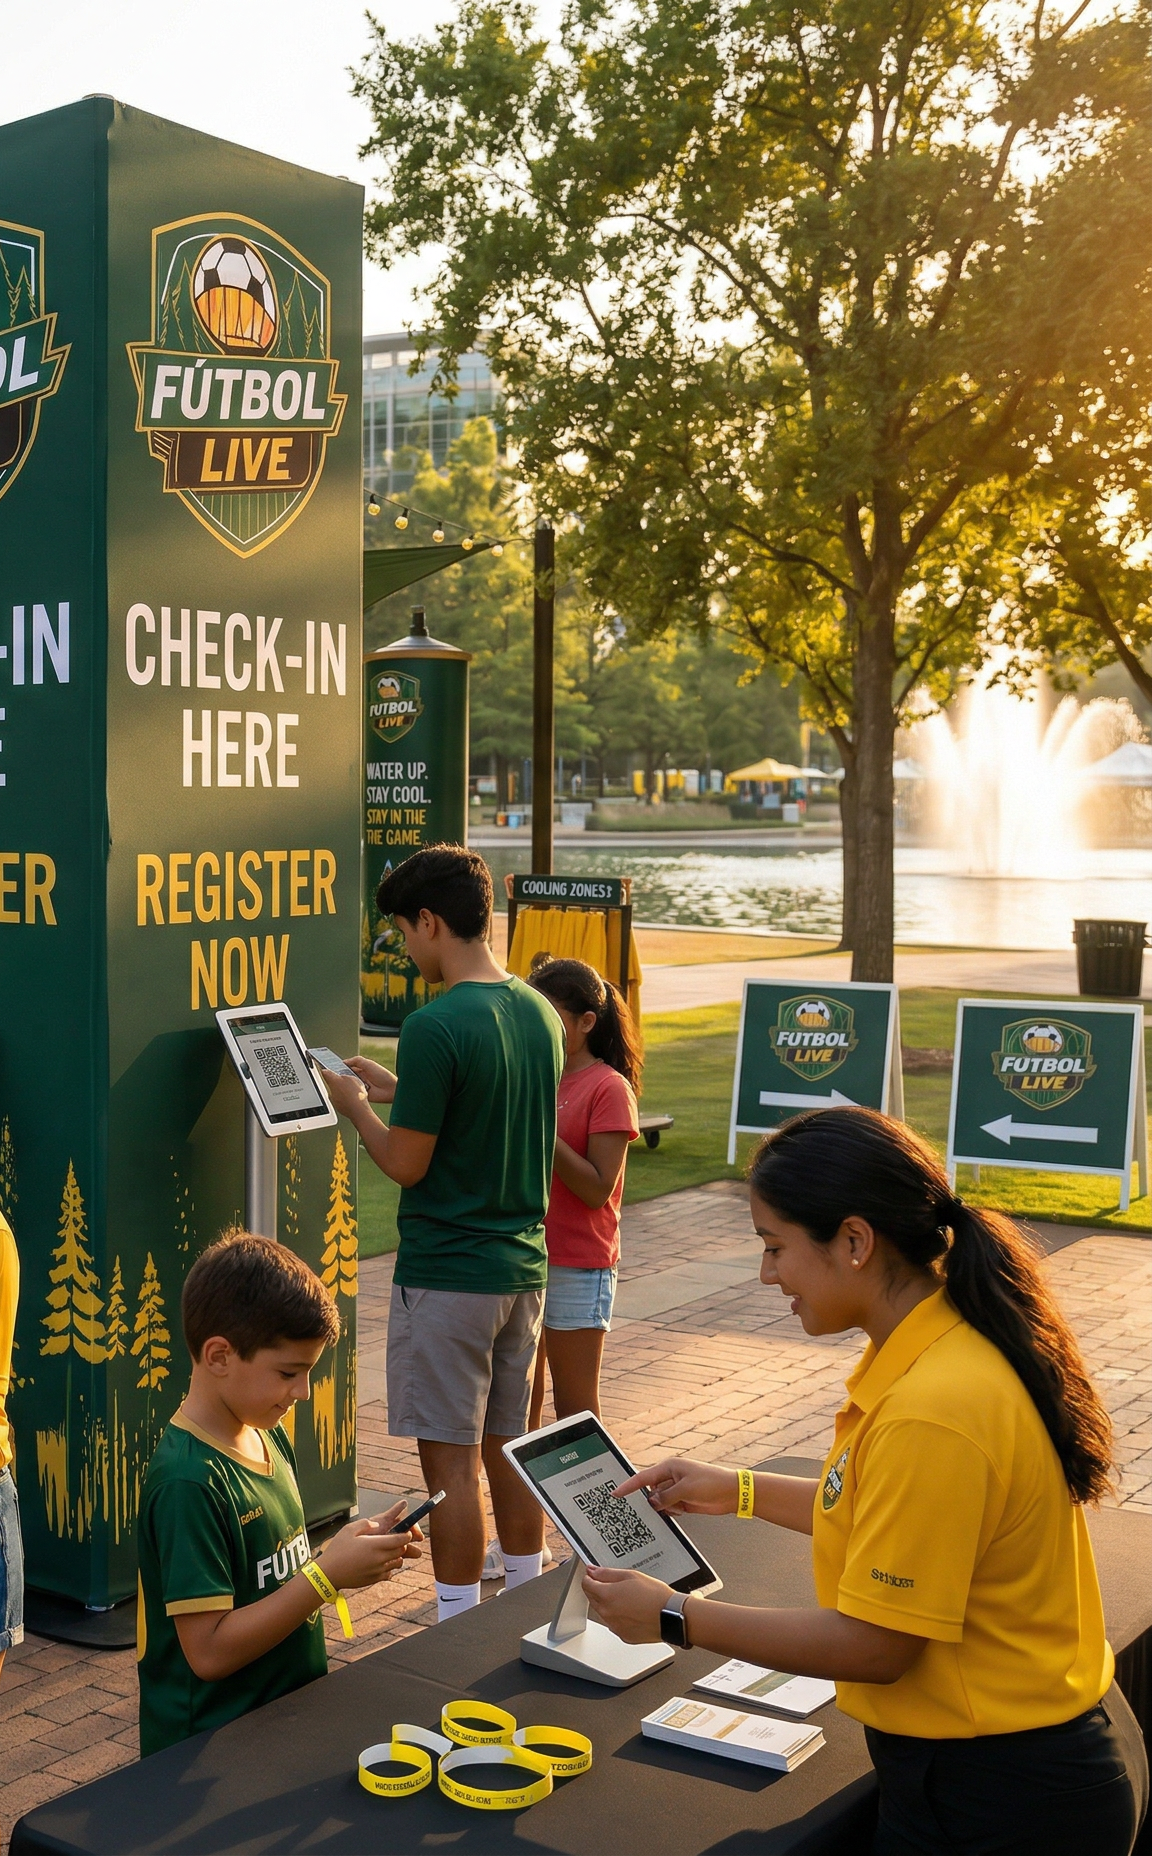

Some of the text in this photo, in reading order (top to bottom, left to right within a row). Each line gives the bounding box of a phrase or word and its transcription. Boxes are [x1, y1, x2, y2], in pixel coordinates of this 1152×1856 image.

[150, 357, 327, 421] FÚTBOL
[199, 437, 294, 482] LIVE
[125, 602, 348, 696] CHECK-IN
[378, 715, 404, 729] LIVE
[182, 708, 300, 789] HERE
[366, 762, 428, 780] WATER UP.
[366, 786, 432, 804] STAY COOL.
[366, 809, 427, 825] STAY IN THE
[136, 849, 337, 926] REGISTER
[522, 880, 567, 896] COOLING
[191, 933, 290, 1011] NOW
[794, 1049, 834, 1062] LIVE
[1021, 1076, 1068, 1090] LIVE
[257, 1533, 312, 1590] FÚTB
